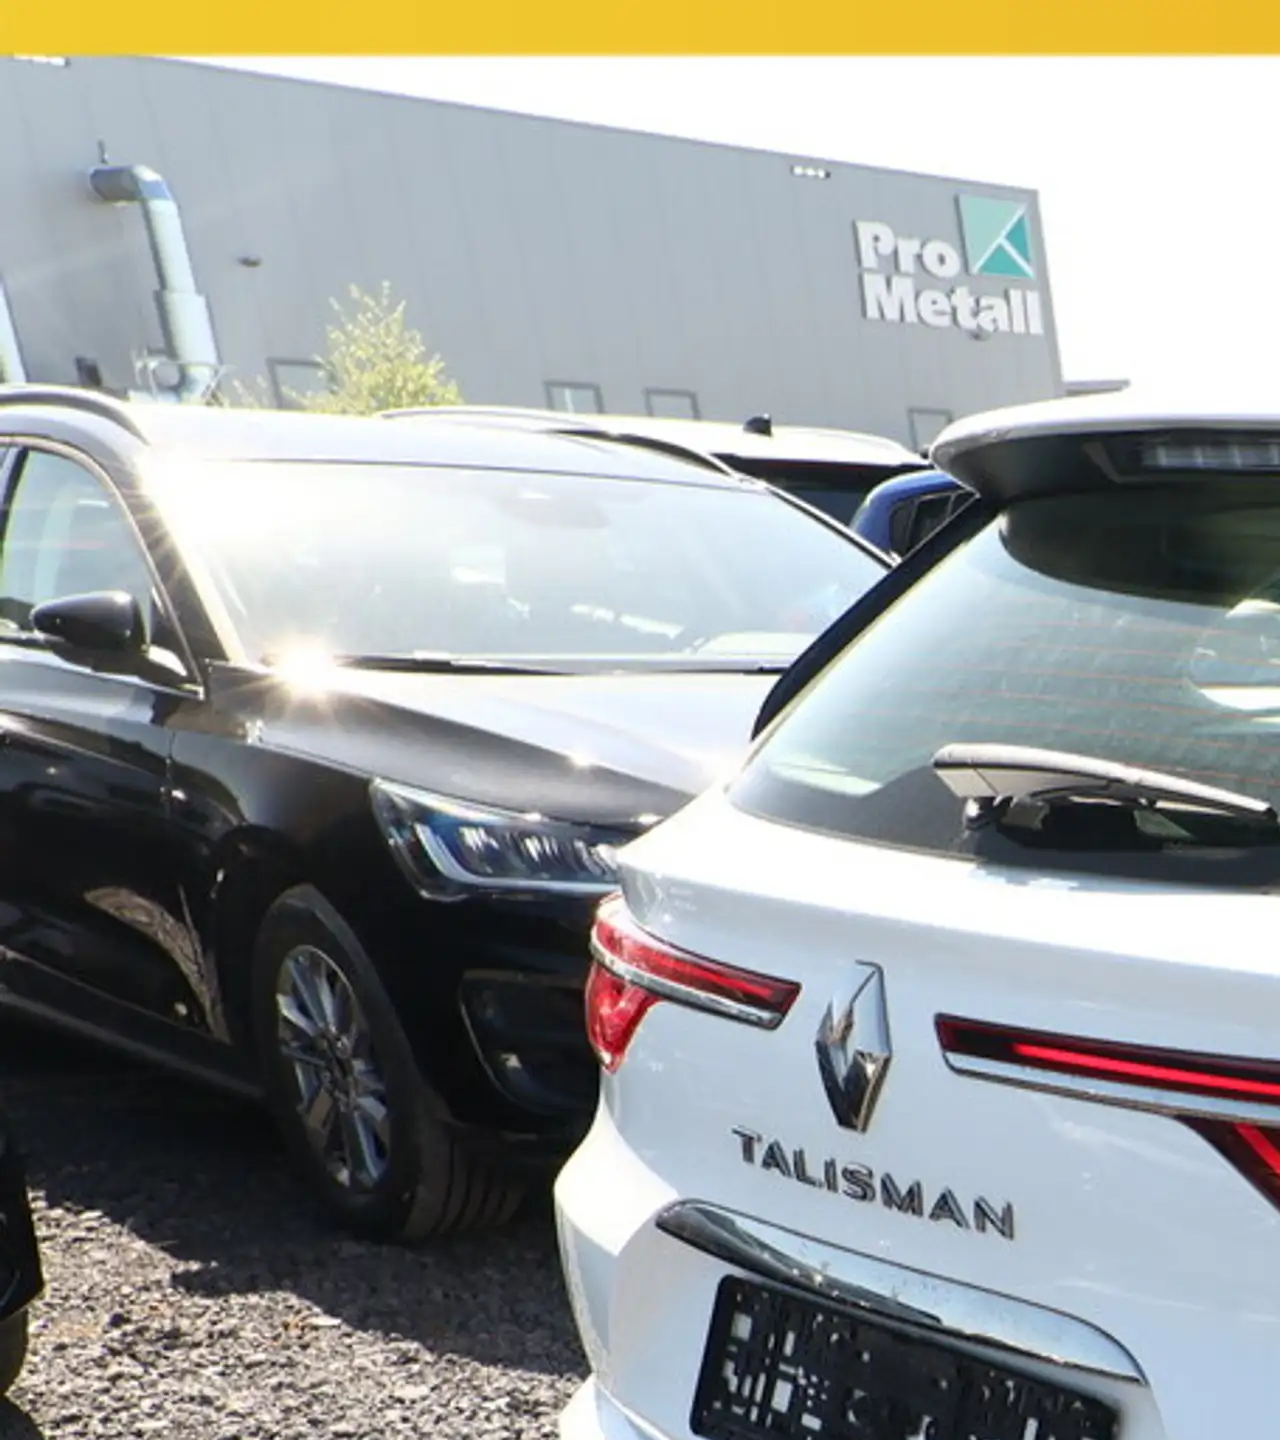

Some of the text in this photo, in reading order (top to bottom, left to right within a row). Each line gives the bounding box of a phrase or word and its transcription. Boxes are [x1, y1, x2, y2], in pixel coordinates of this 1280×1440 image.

[855, 220, 960, 278] Pro
[861, 272, 1043, 336] Metall
[732, 1126, 1016, 1240] TALISMAN
